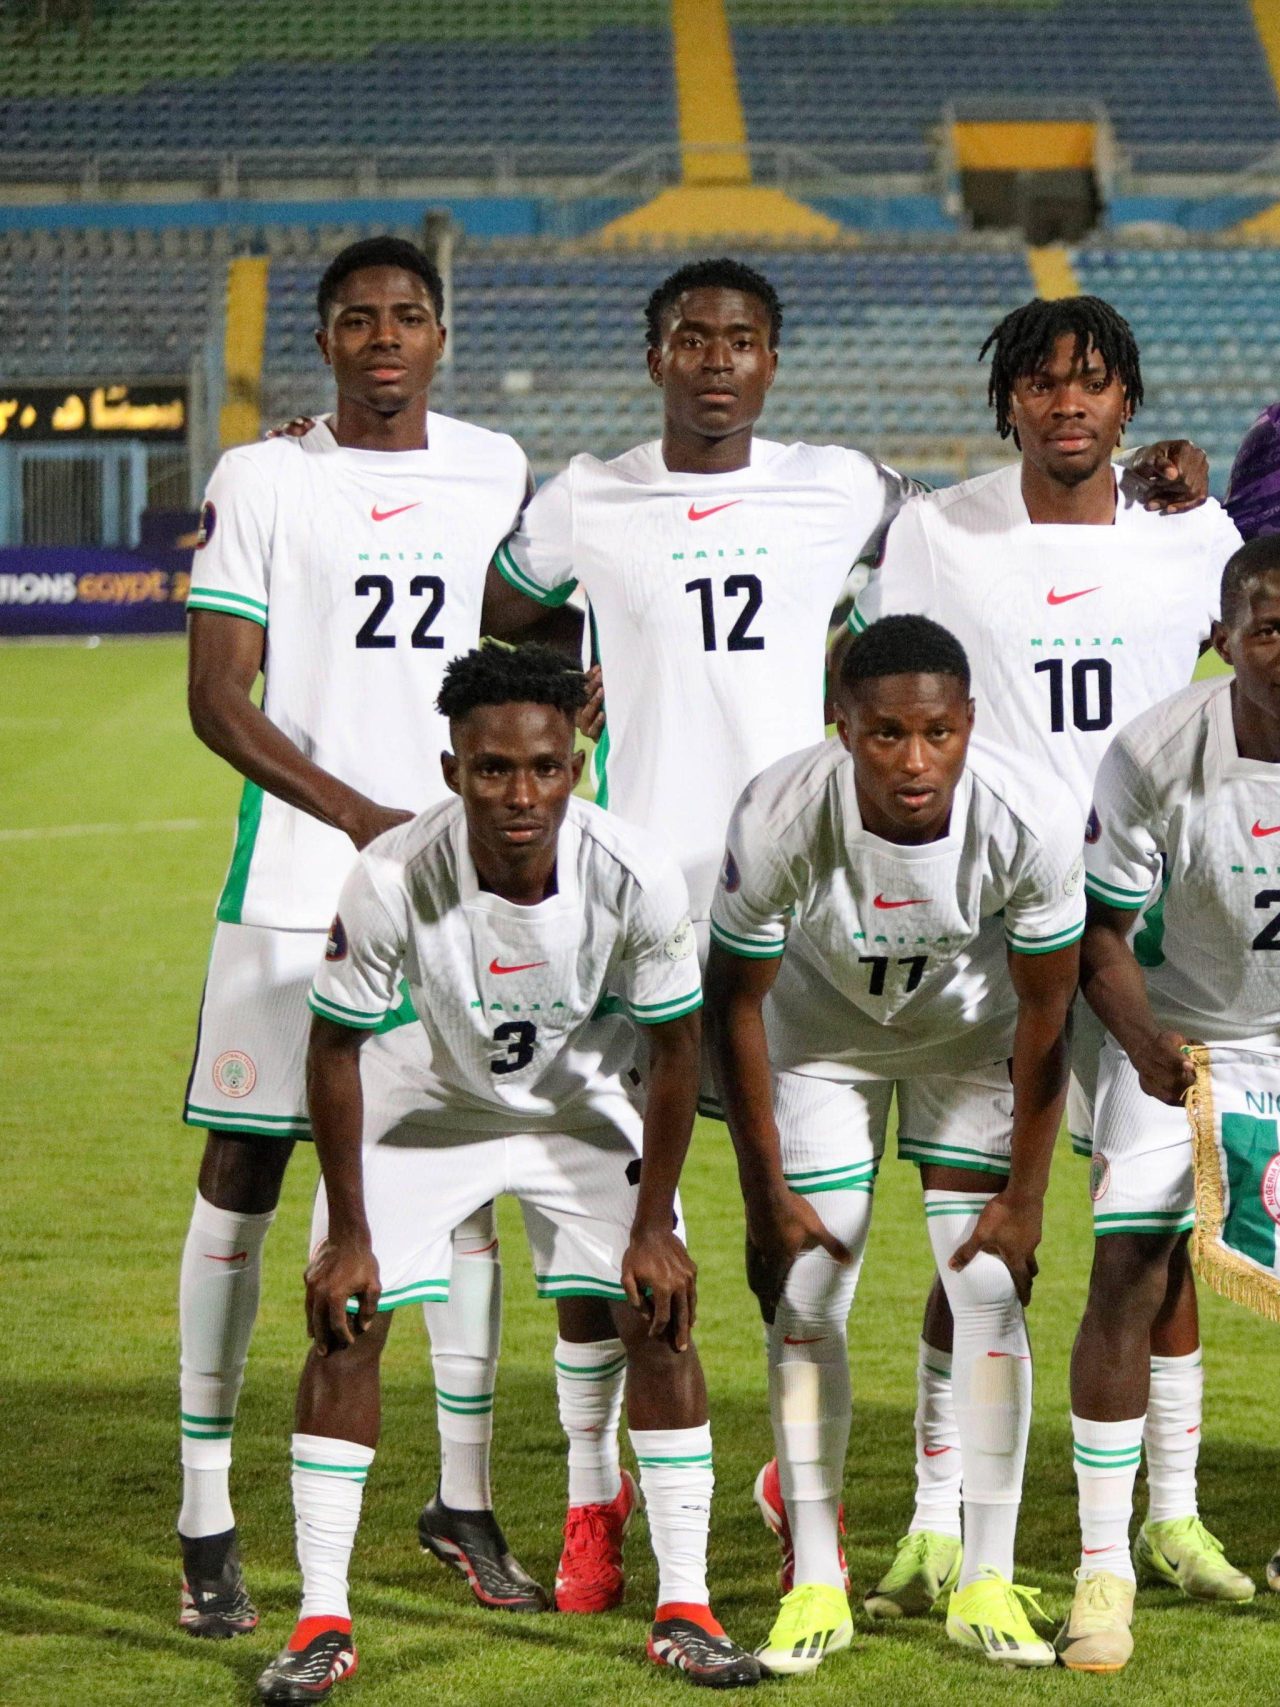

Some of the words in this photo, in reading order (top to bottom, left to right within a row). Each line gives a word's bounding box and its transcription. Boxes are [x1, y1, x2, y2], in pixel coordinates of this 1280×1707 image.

[358, 552, 443, 561] NAIJA
[671, 547, 768, 560] NAIJA
[355, 575, 445, 649] 22
[685, 574, 764, 652] 12
[1030, 637, 1124, 646] NAIJA
[1034, 658, 1113, 733] 10
[858, 955, 929, 996] 11
[490, 1021, 537, 1075] 3
[1263, 1167, 1278, 1207] NIGERIA
